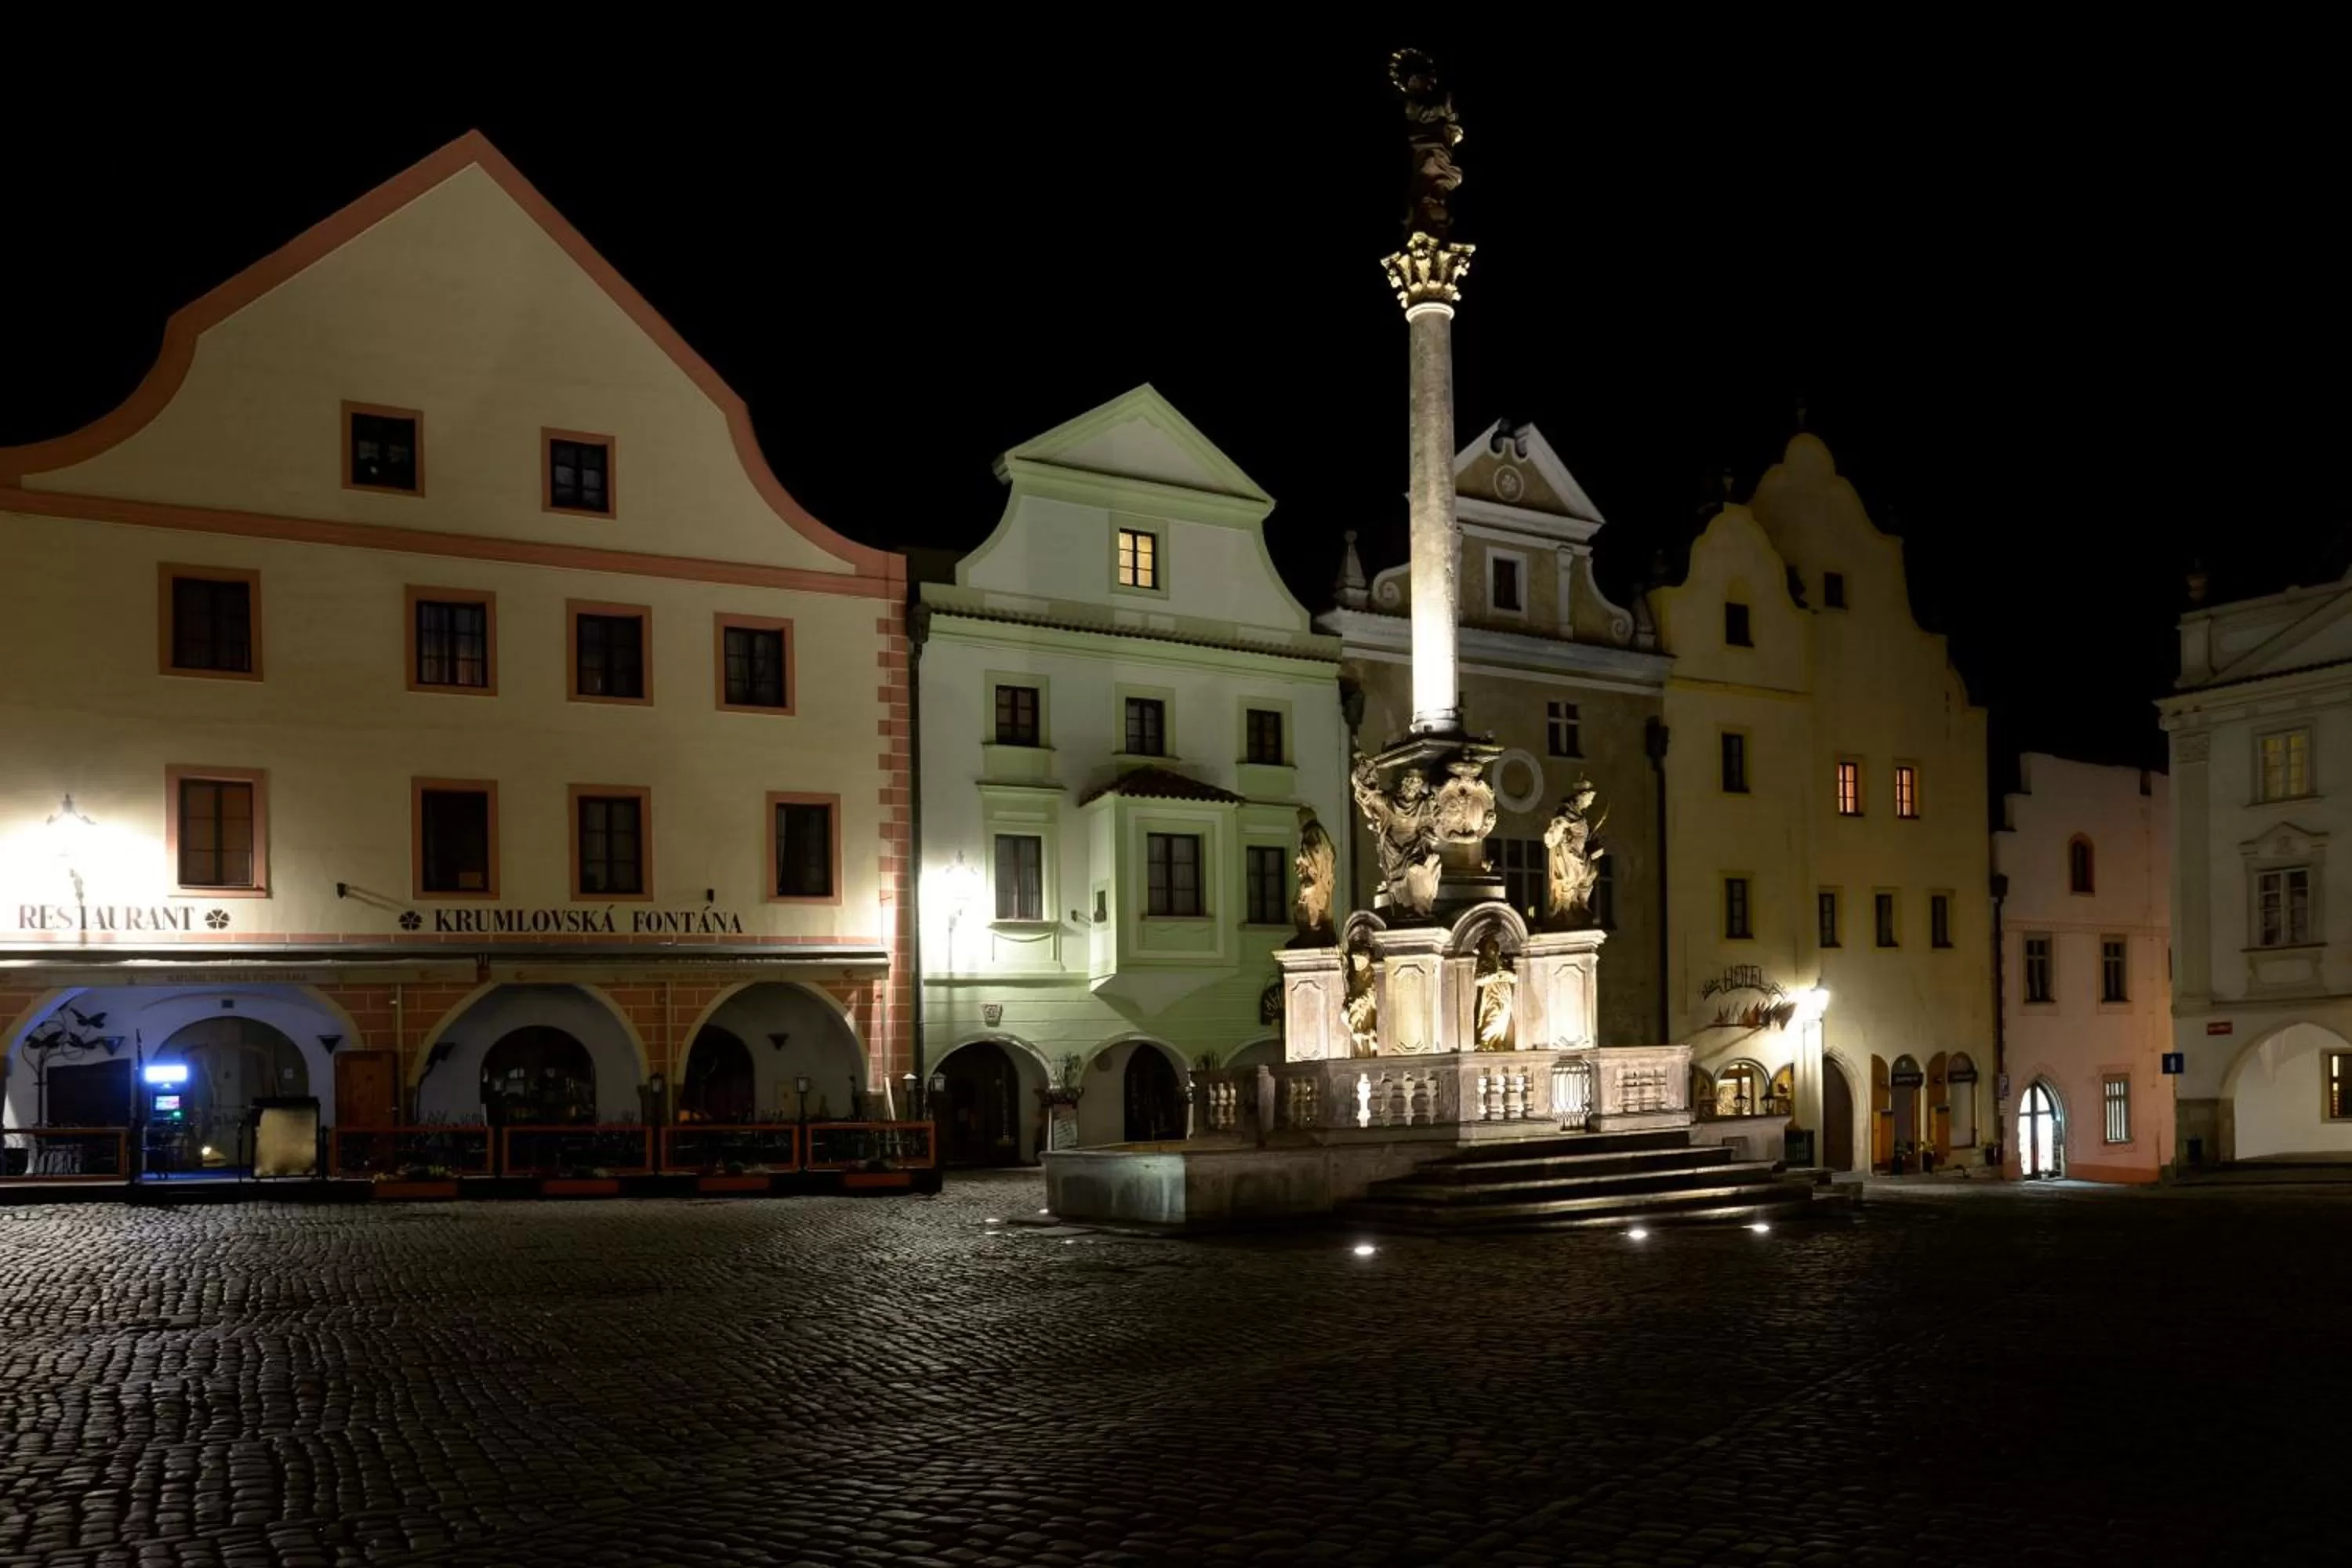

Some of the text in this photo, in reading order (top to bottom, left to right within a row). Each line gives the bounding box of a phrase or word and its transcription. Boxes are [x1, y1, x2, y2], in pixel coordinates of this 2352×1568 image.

[19, 904, 195, 931] RESTAURANT
[435, 904, 743, 934] KRUMLOVSKÁ FONTÁNA
[1723, 964, 1762, 991] HOTEL
